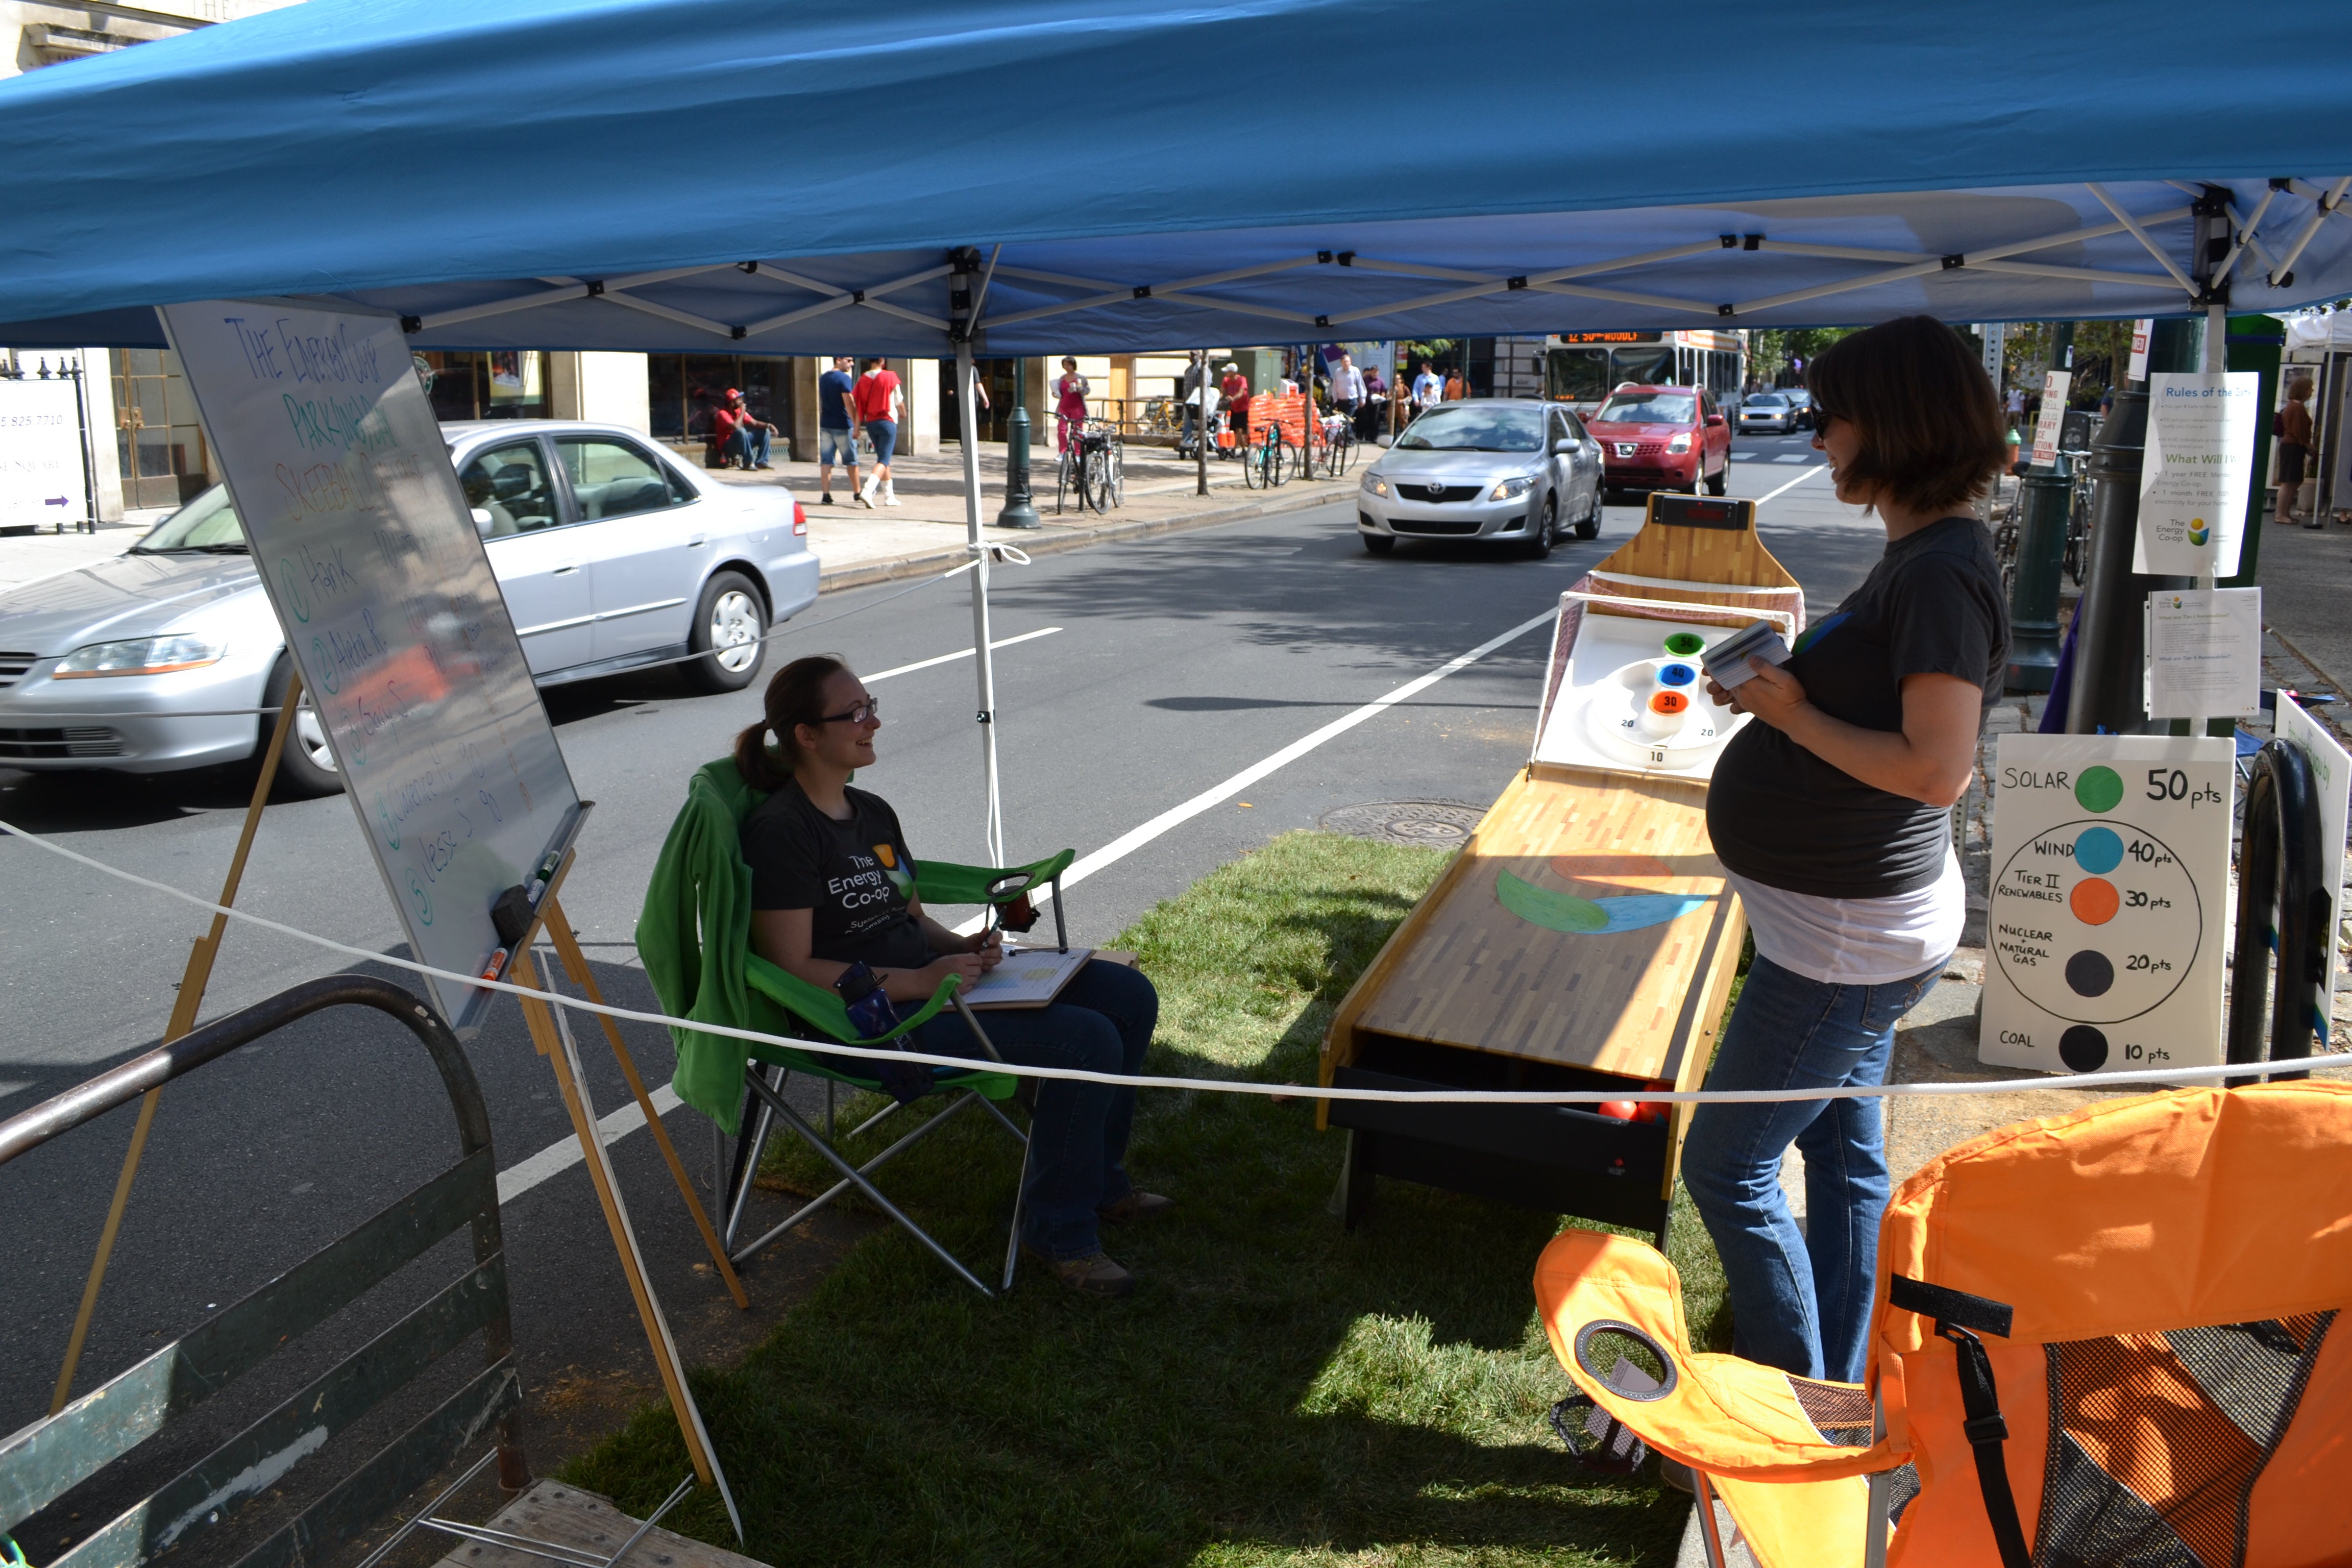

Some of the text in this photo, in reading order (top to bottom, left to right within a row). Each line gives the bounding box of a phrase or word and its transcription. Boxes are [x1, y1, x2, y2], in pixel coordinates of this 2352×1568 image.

[224, 318, 282, 379] THE
[276, 318, 351, 383] ENERGY
[2166, 387, 2198, 397] Rules
[2202, 386, 2214, 397] of
[2218, 387, 2232, 397] the
[2166, 454, 2197, 464] What
[2201, 454, 2222, 464] Will
[276, 462, 374, 521] SKEEBALL
[2156, 525, 2184, 535] Energy
[2158, 534, 2183, 543] Co-op
[299, 544, 358, 604] Hank
[1680, 637, 1693, 647] 50
[1672, 667, 1684, 678] 40
[1664, 696, 1677, 706] 30
[1621, 719, 1634, 727] 20
[1651, 751, 1663, 762] 10
[2323, 755, 2331, 791] by
[2001, 768, 2222, 809] SOLAR 50 pts
[479, 790, 502, 829] 90
[848, 855, 874, 869] The
[2035, 839, 2172, 868] WIND 40 pts
[828, 870, 882, 895] Energy
[2014, 870, 2060, 889] TIER II
[842, 886, 890, 909] Co-op
[1998, 884, 2172, 911] RENEWABLES 30 pts
[1999, 924, 2053, 942] NUCLEAR
[1999, 942, 2172, 974] NATURAL 20 pts
[2013, 953, 2037, 967] GAS
[2000, 1030, 2170, 1064] COAL 10 pts
